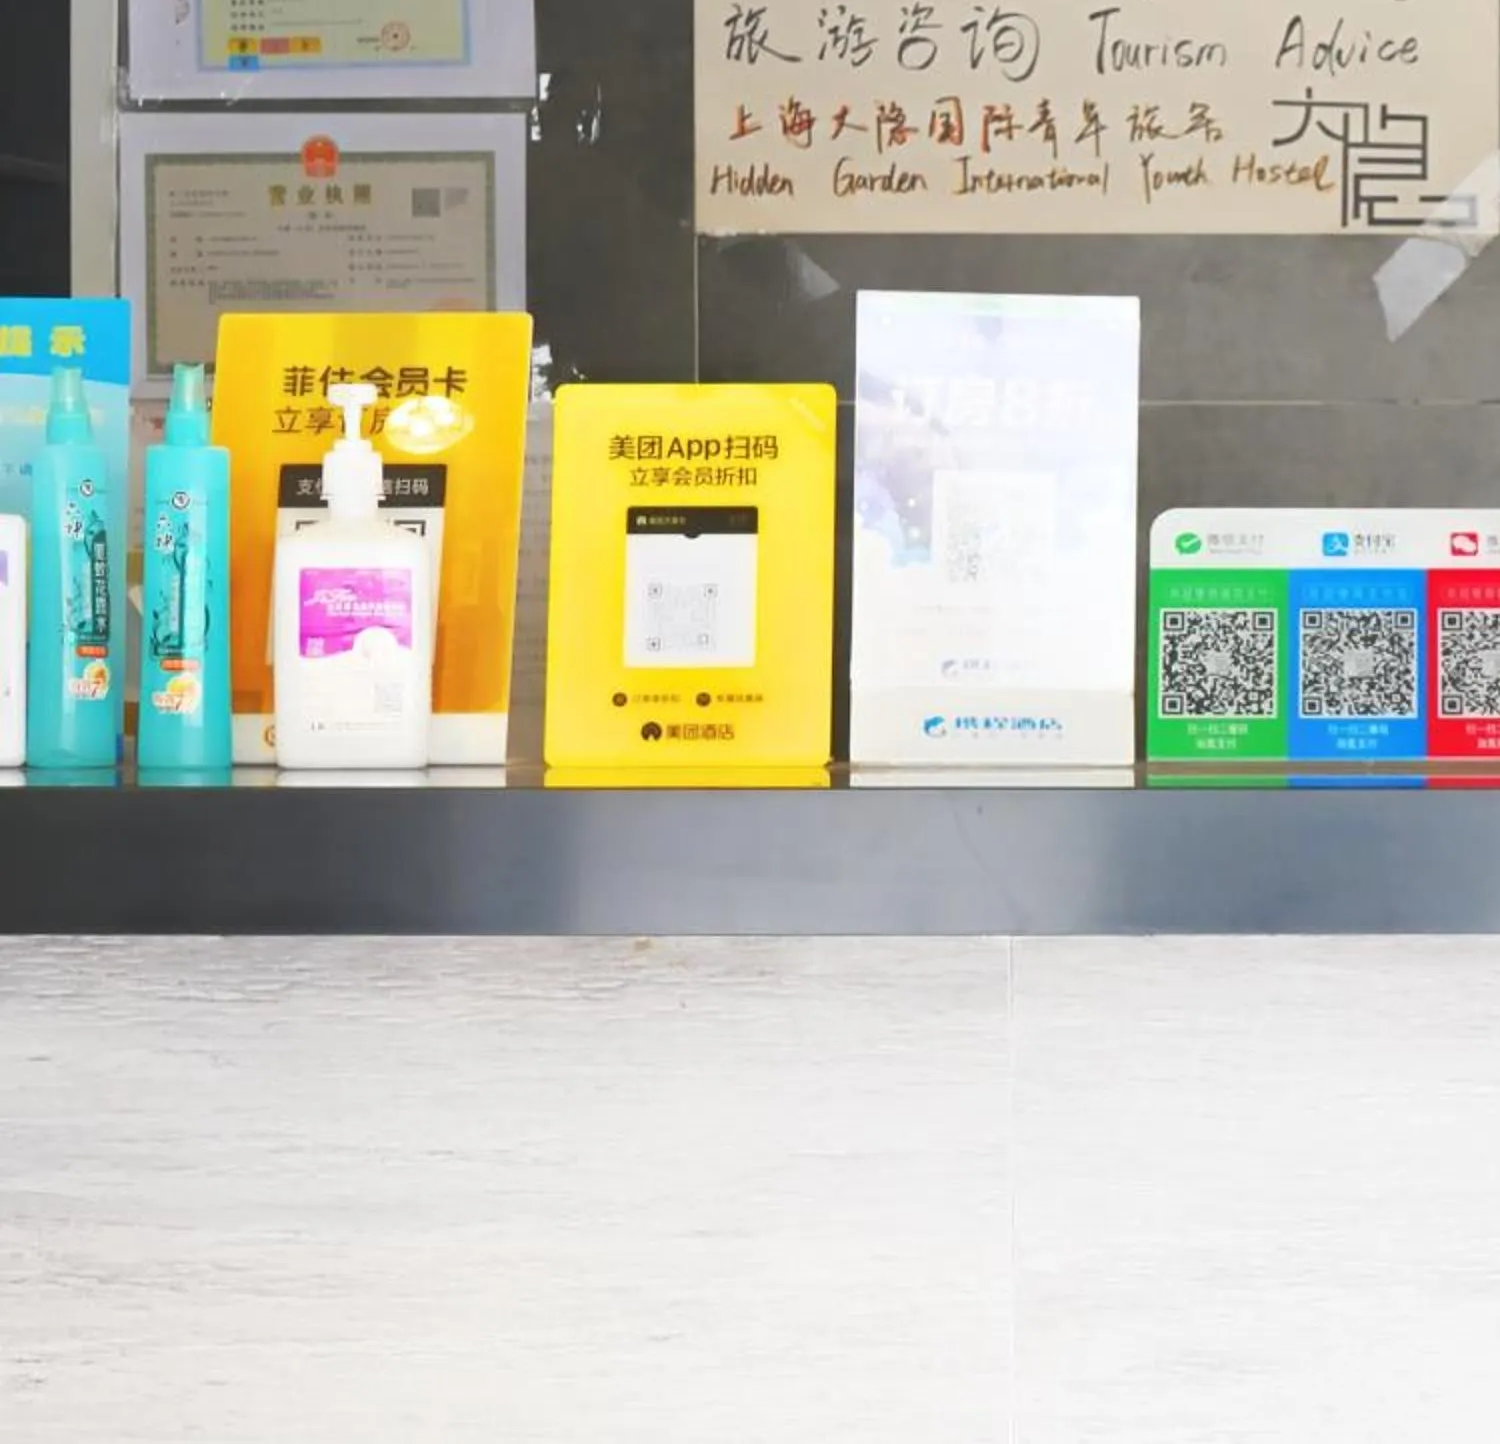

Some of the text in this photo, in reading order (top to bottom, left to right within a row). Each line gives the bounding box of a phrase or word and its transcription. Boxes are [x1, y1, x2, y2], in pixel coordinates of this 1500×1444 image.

[724, 4, 1041, 82] 旅游咨询
[1088, 7, 1421, 75] Tourism Advice
[710, 163, 795, 198] Hidden
[832, 155, 928, 198] Garden
[1139, 152, 1210, 204] Youth
[1232, 153, 1337, 193] Hostel
[629, 466, 758, 487] 立享会员折扣
